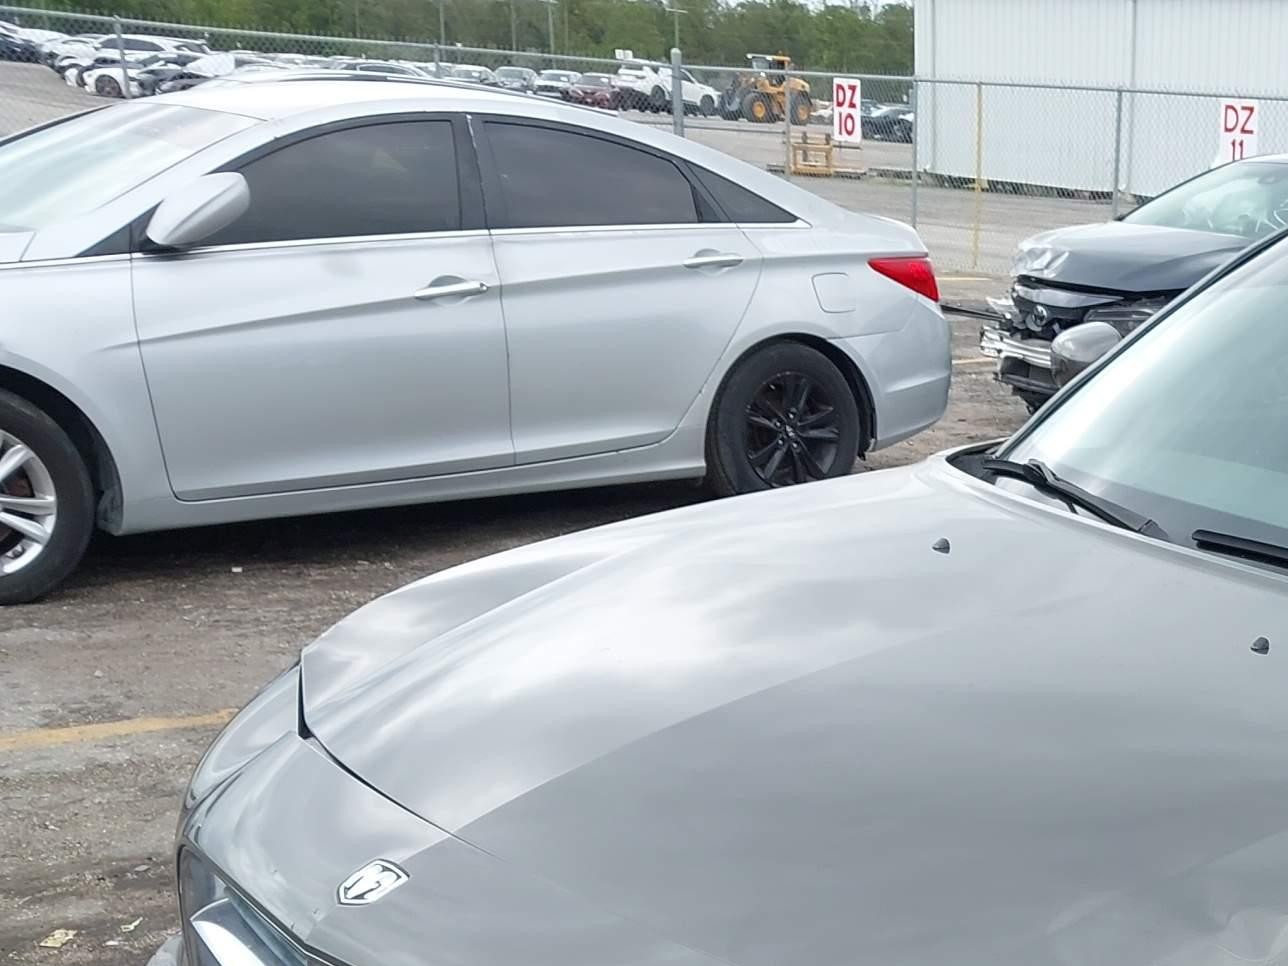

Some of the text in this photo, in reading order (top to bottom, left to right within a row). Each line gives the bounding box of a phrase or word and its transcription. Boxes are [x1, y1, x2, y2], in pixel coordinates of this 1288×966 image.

[836, 83, 857, 109] DZ
[838, 111, 855, 137] 10
[1224, 104, 1255, 135] DZ
[1231, 138, 1244, 162] 11
